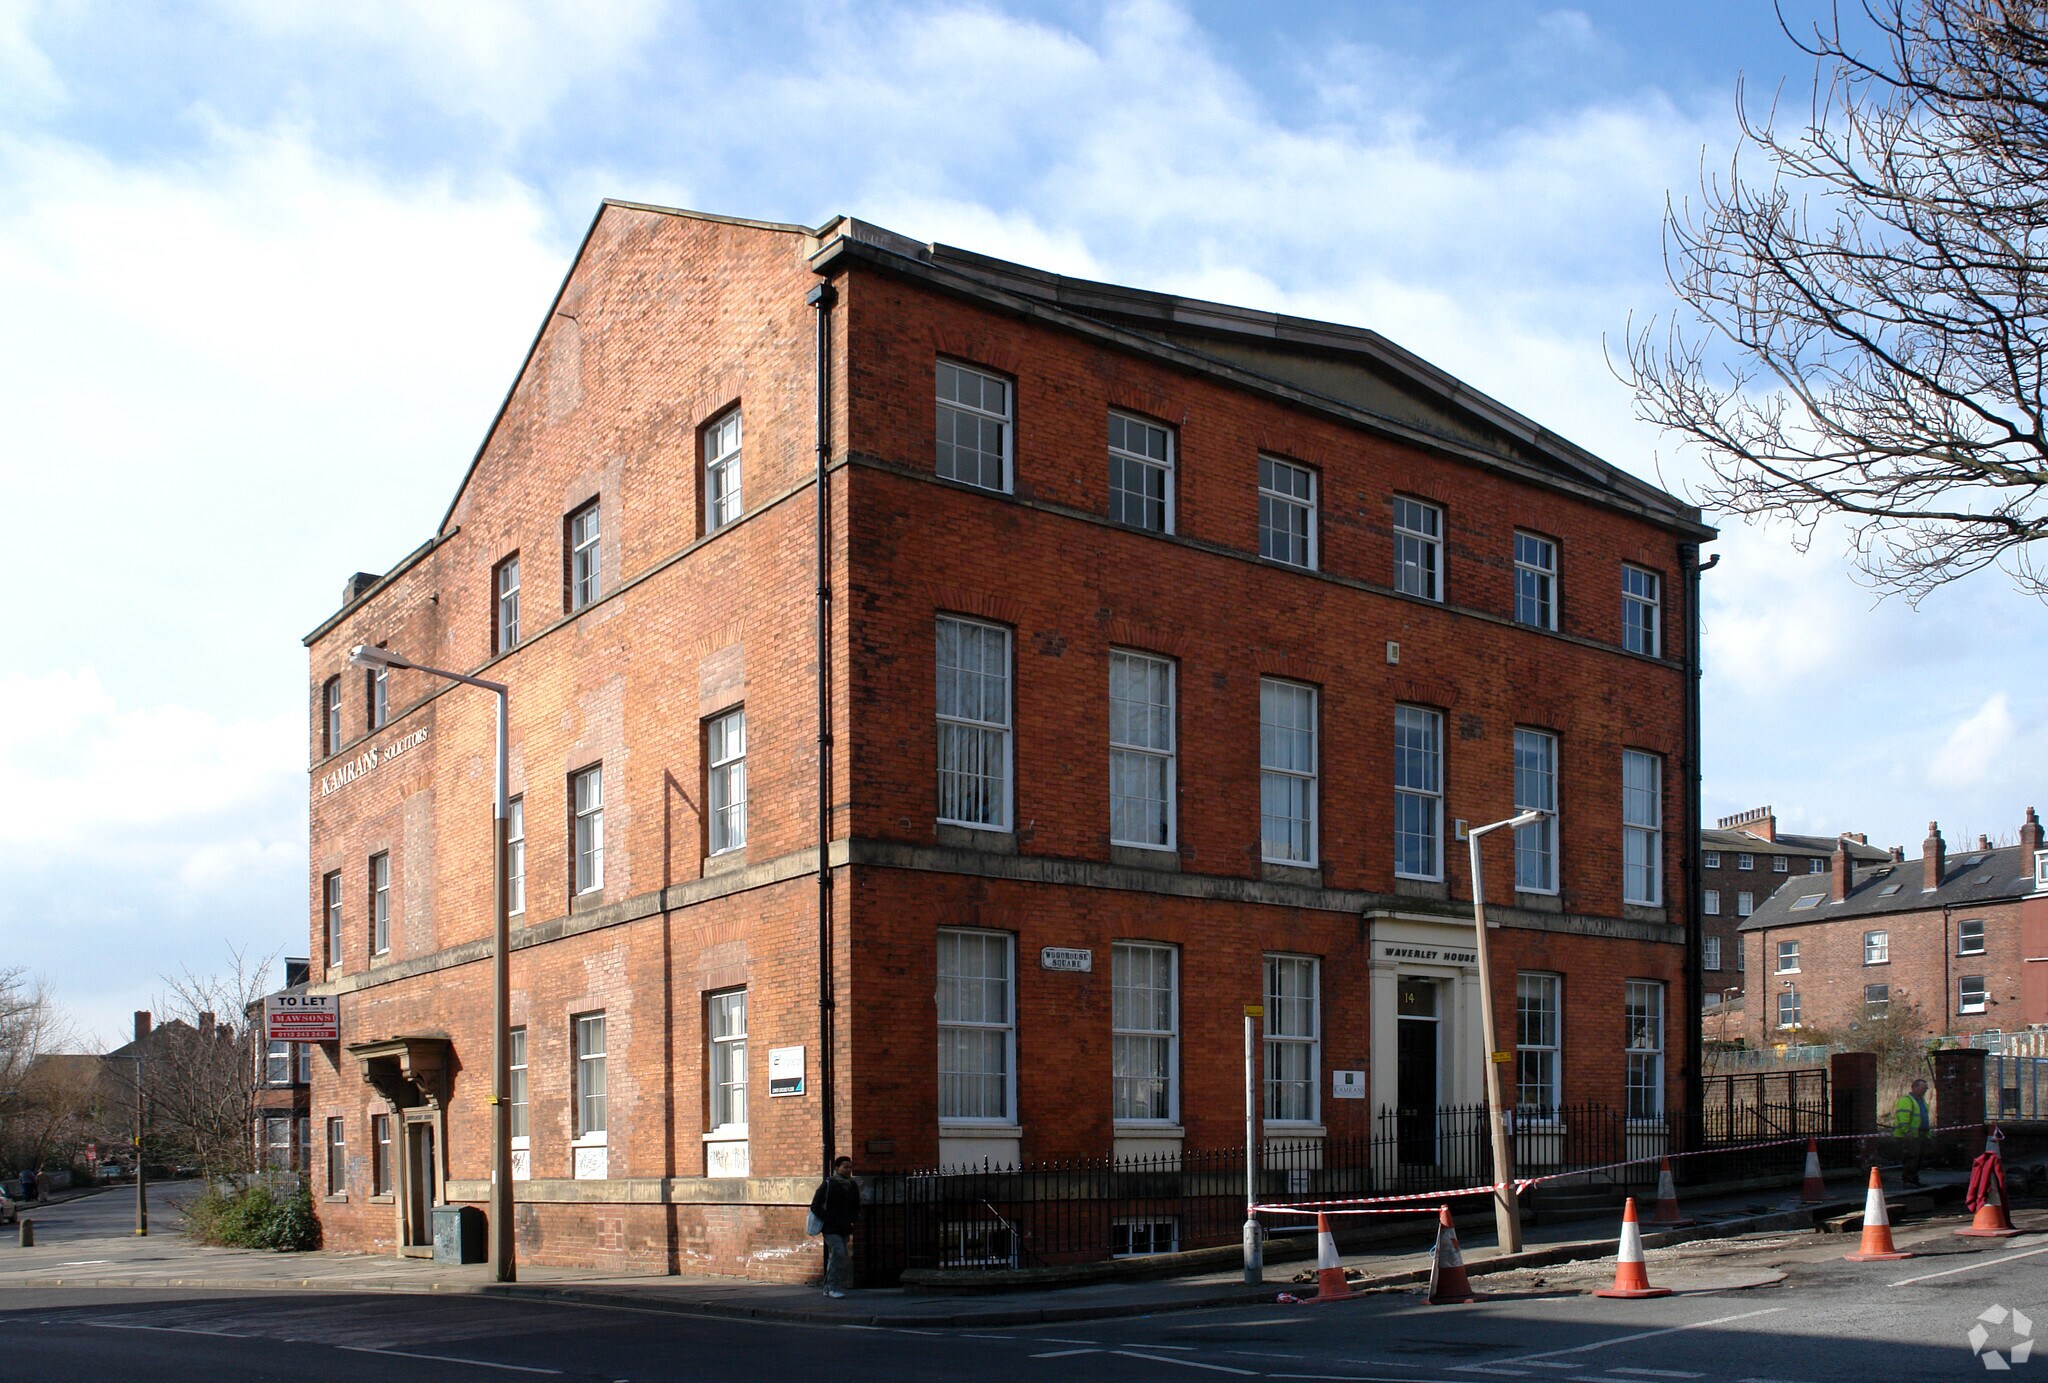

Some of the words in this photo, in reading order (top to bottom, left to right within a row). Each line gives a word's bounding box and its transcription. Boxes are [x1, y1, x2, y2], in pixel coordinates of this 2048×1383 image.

[321, 746, 379, 797] KAMRANS
[383, 726, 429, 762] SOLICITORS
[1045, 951, 1088, 960] WOODHOUSE
[1384, 947, 1438, 959] WAVERLEY
[1443, 952, 1476, 963] HOUSE
[1052, 959, 1082, 967] SQUARE
[278, 997, 297, 1006] TO
[302, 997, 327, 1006] LET
[1404, 992, 1415, 1004] 14
